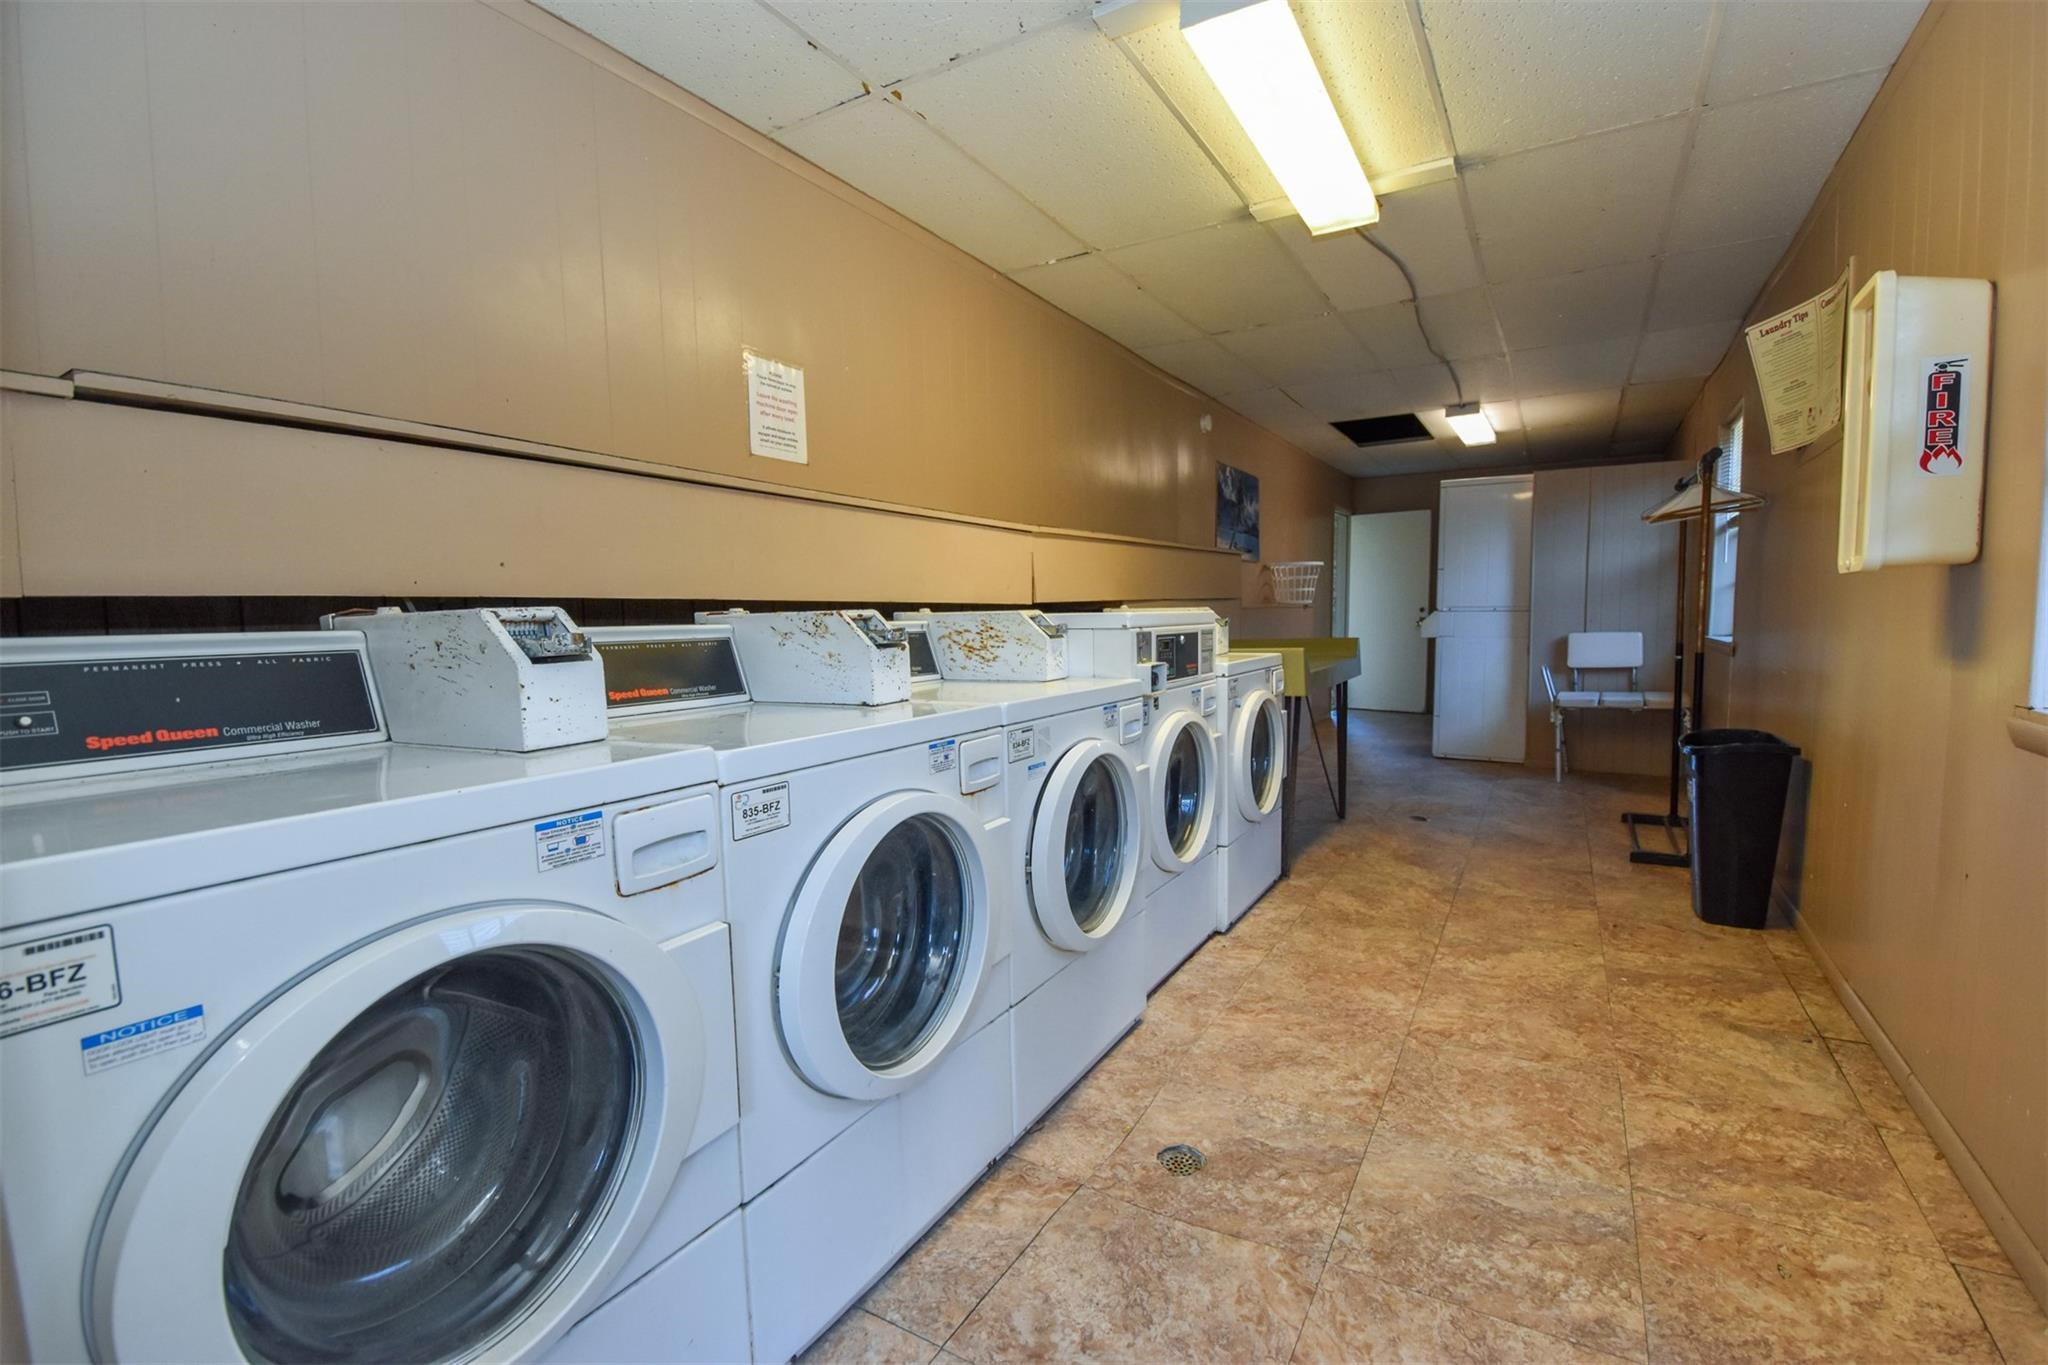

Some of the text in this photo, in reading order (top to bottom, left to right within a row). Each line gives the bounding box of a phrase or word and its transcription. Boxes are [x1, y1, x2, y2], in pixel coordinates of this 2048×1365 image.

[1760, 312, 1808, 338] Laundry Tips
[1927, 373, 1957, 446] FIRE
[83, 663, 165, 672] PERMANENT
[608, 689, 639, 701] Speed
[640, 687, 669, 697] Queen
[670, 686, 698, 695] Commercial
[86, 720, 321, 750] Speed Queen Commercial Washer
[742, 800, 781, 819] 835-BFZ
[556, 816, 584, 826] NOTICE
[100, 1012, 188, 1044] NOTICE
